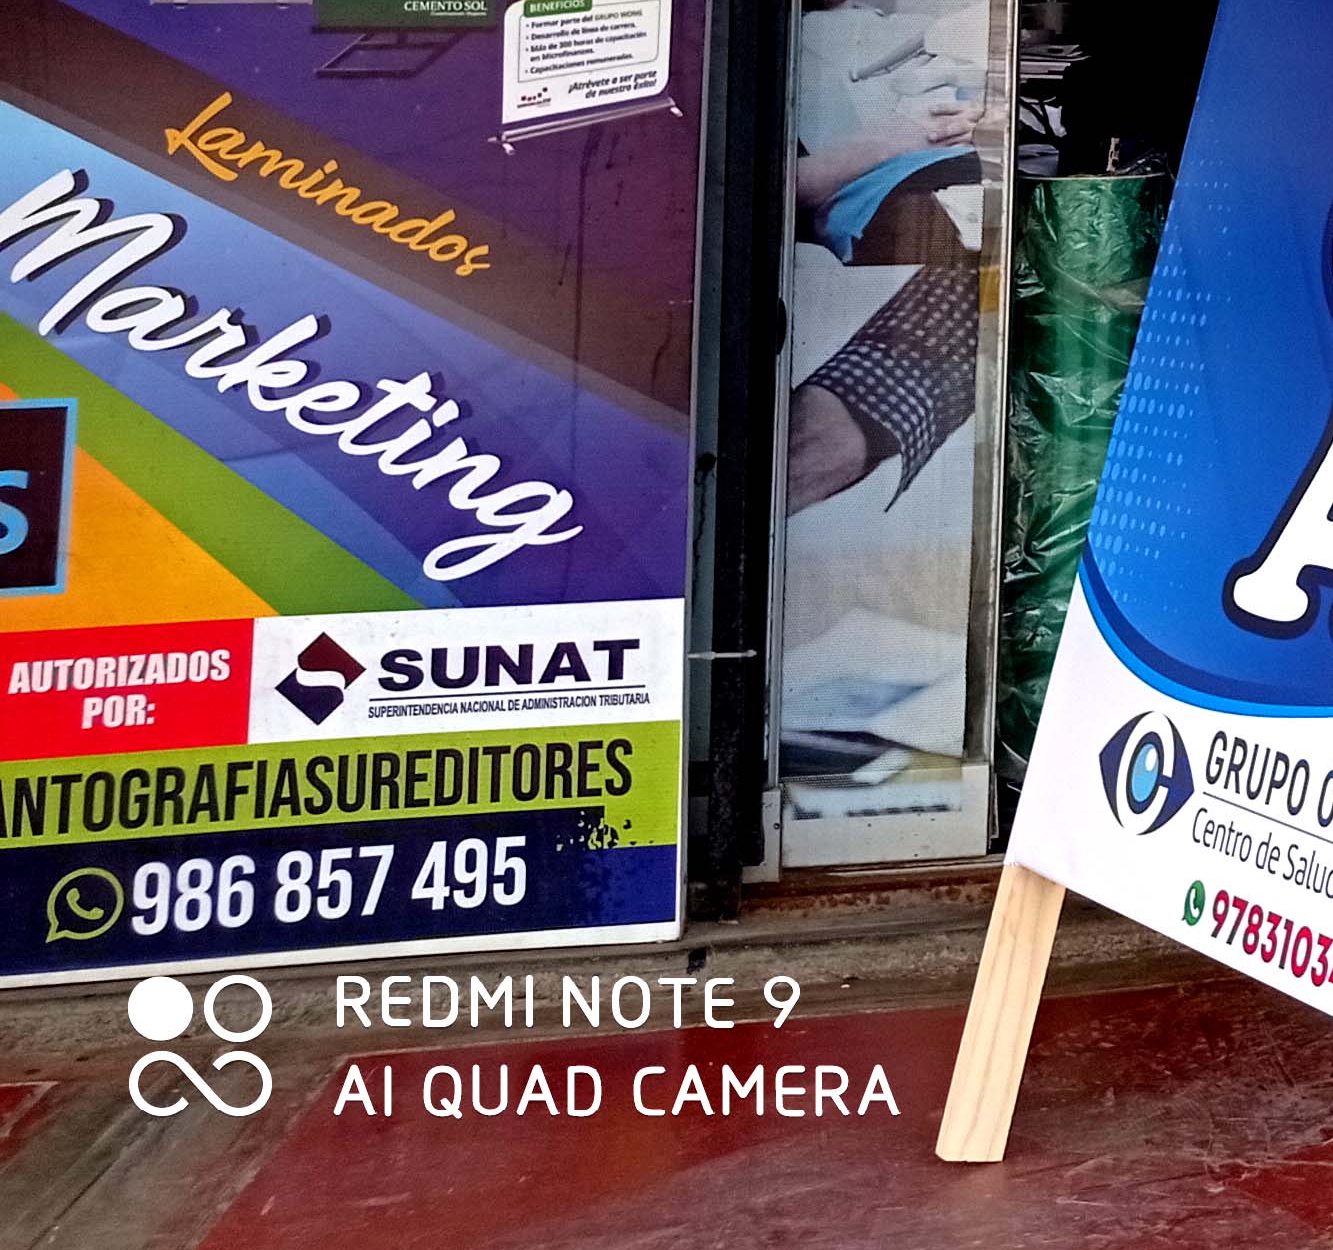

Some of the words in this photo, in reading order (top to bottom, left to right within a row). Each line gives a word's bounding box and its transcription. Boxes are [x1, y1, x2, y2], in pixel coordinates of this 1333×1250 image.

[404, 0, 462, 12] CEMENTO
[464, 0, 488, 12] SOL
[529, 0, 586, 14] BENEFICIOS
[164, 92, 492, 277] Laminados
[0, 168, 584, 582] Marketing
[8, 649, 231, 695] AUTORIZADOS
[378, 638, 640, 692] SUNAT
[81, 694, 155, 730] POR:
[368, 699, 459, 719] SUPERINTENDENCIA
[459, 698, 507, 715] NACIONAL
[507, 698, 521, 712] DE
[521, 695, 598, 711] ADMINISTRACION
[598, 691, 651, 706] TRIBUTARIA
[0, 738, 633, 839] NTOGRAFIASUREDITORES
[1204, 730, 1311, 816] GRUPO
[1191, 807, 1252, 865] Centro
[1255, 832, 1282, 875] de
[131, 858, 256, 937] 986
[274, 844, 395, 924] 857
[411, 834, 528, 912] 495
